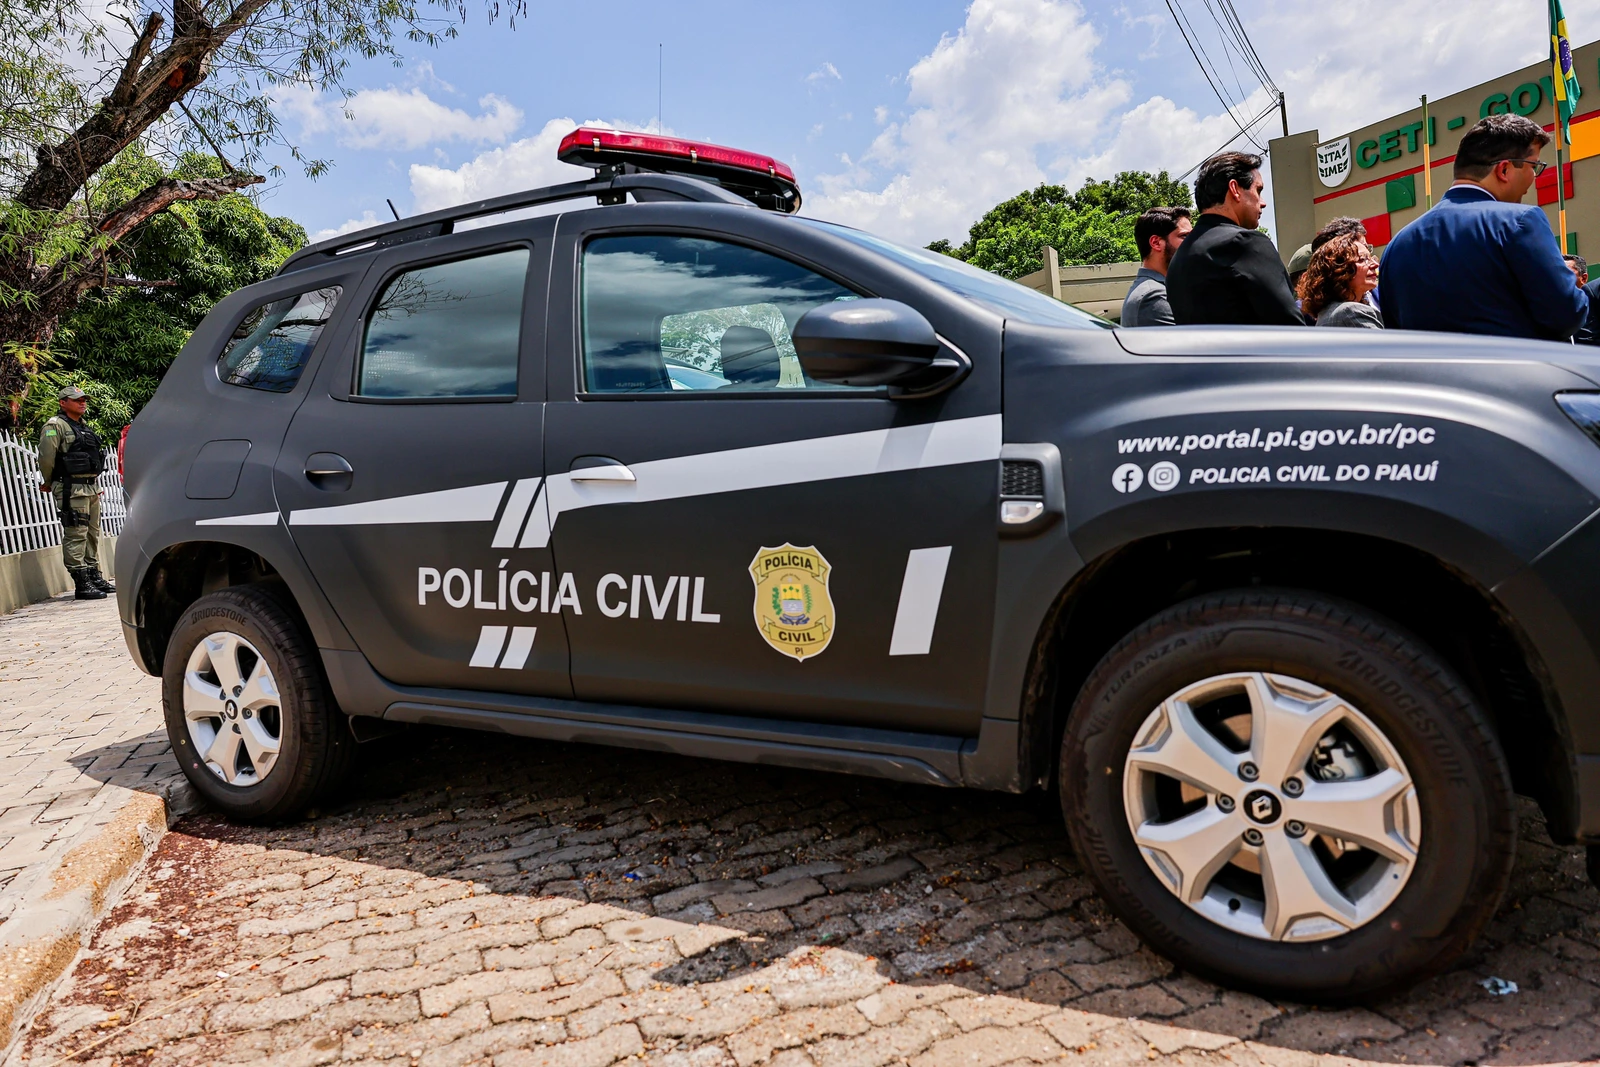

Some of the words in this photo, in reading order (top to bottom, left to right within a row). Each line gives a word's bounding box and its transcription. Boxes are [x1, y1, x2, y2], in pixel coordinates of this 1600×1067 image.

[1356, 116, 1435, 169] CETI
[1117, 423, 1437, 455] www.portal.pi.gov.br/pc
[1189, 465, 1271, 484] POLICIA
[1276, 464, 1331, 482] CIVIL
[1335, 464, 1370, 481] DO
[1374, 460, 1440, 481] PIAUÍ
[764, 552, 814, 571] POLÍCIA
[417, 558, 583, 616] POLÍCIA
[596, 573, 721, 623] CIVIL
[191, 606, 249, 626] BRIDGESTONE
[778, 631, 816, 642] CIVIL
[794, 647, 804, 655] PI
[1102, 637, 1188, 702] TURANZA
[1336, 650, 1470, 788] BRIDGESTONE
